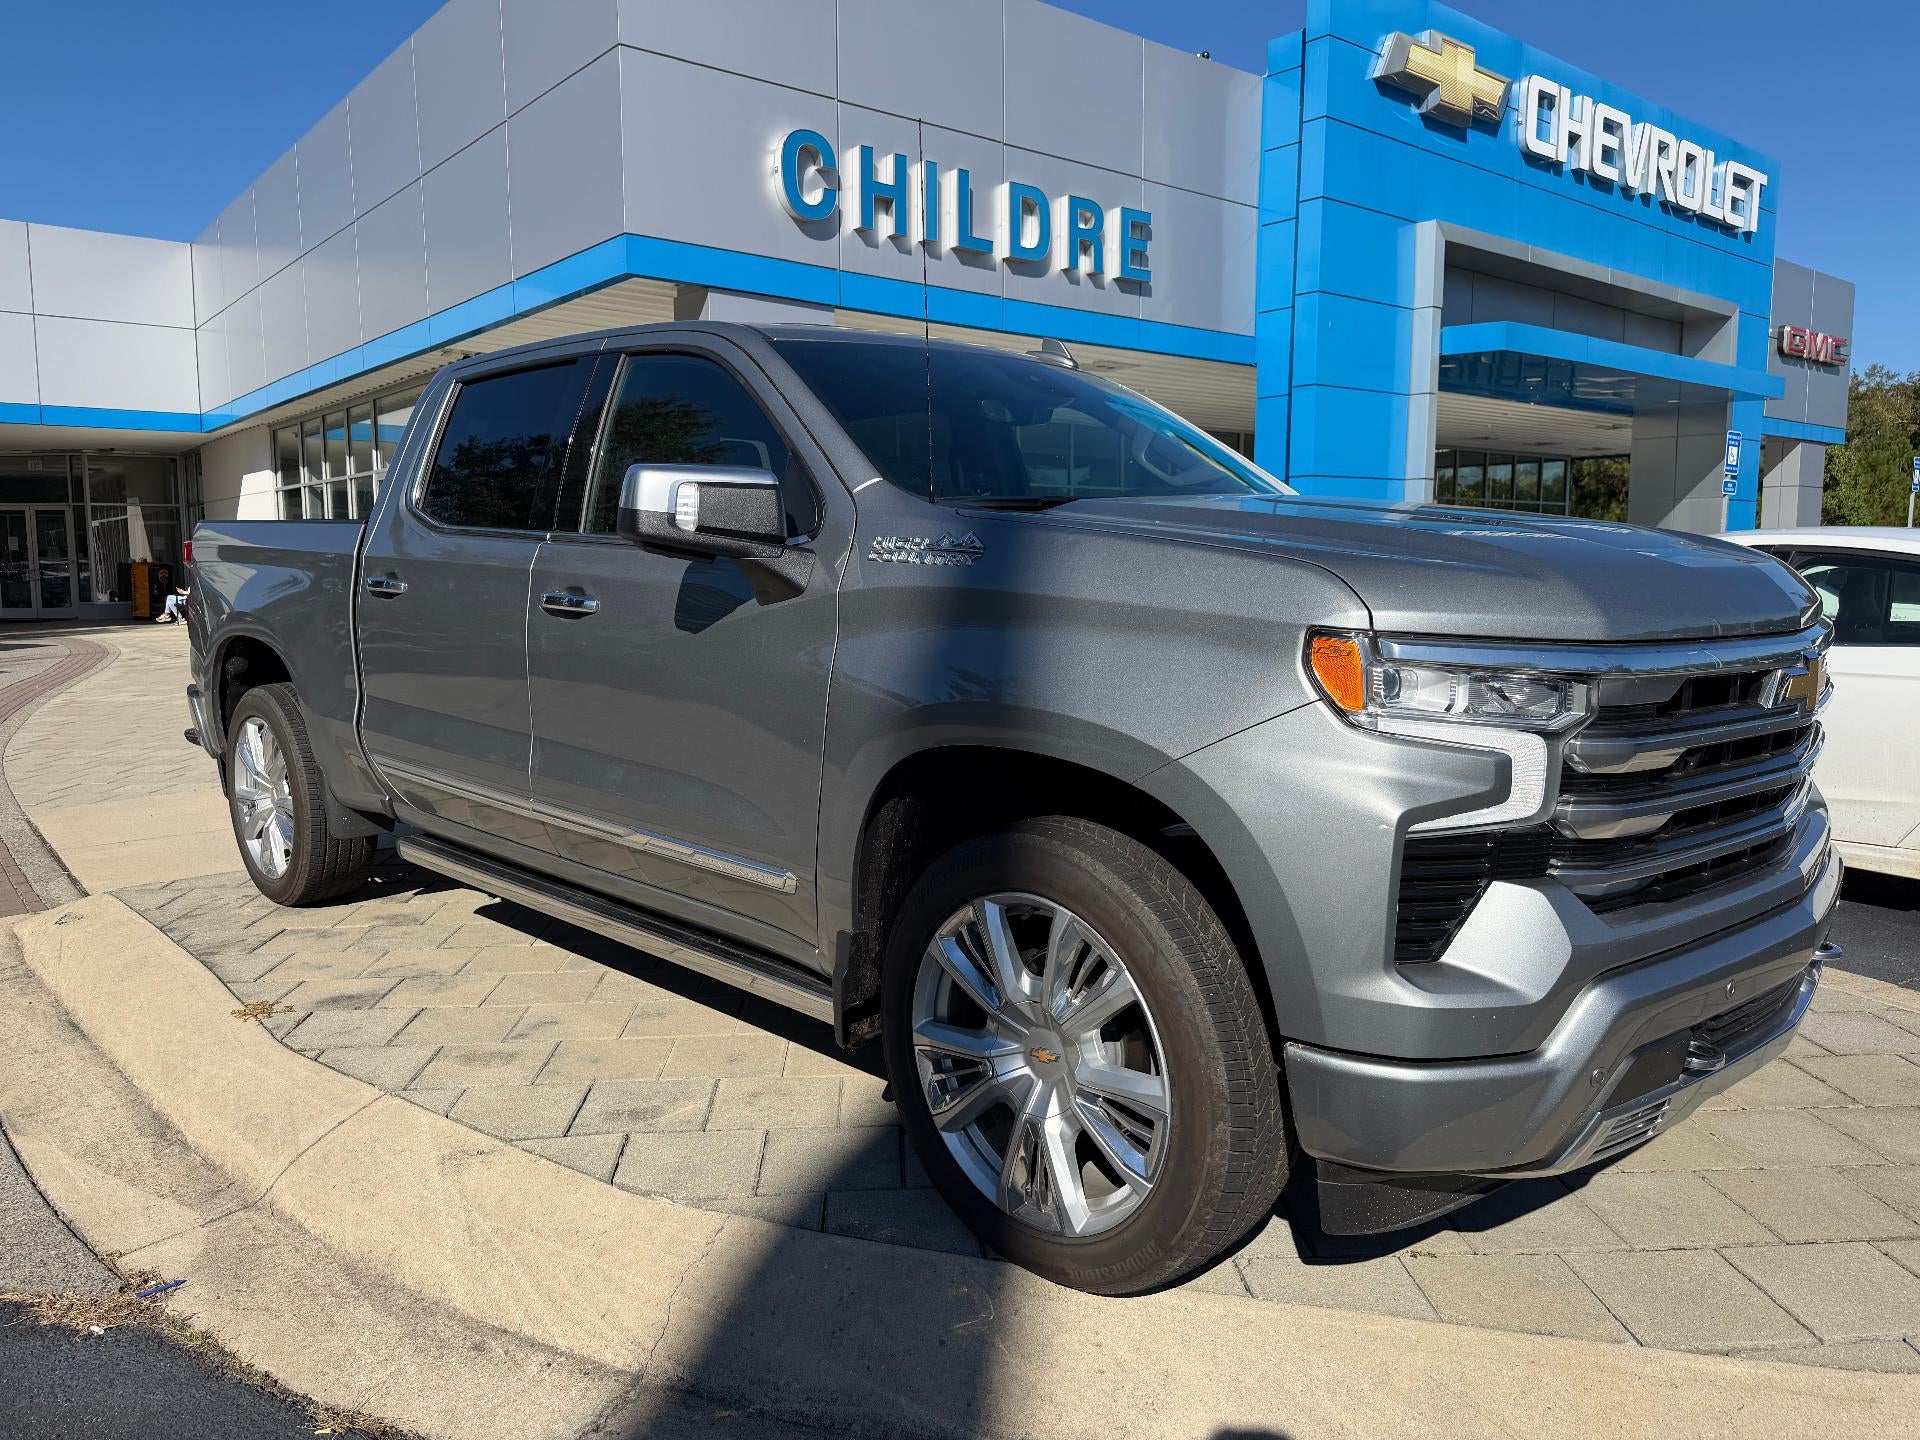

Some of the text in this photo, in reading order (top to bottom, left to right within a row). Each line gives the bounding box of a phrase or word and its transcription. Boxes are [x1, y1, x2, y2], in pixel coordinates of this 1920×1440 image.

[775, 129, 1152, 283] CHILDRE
[1520, 74, 1768, 234] CHEVROLET
[1782, 325, 1849, 366] GMC
